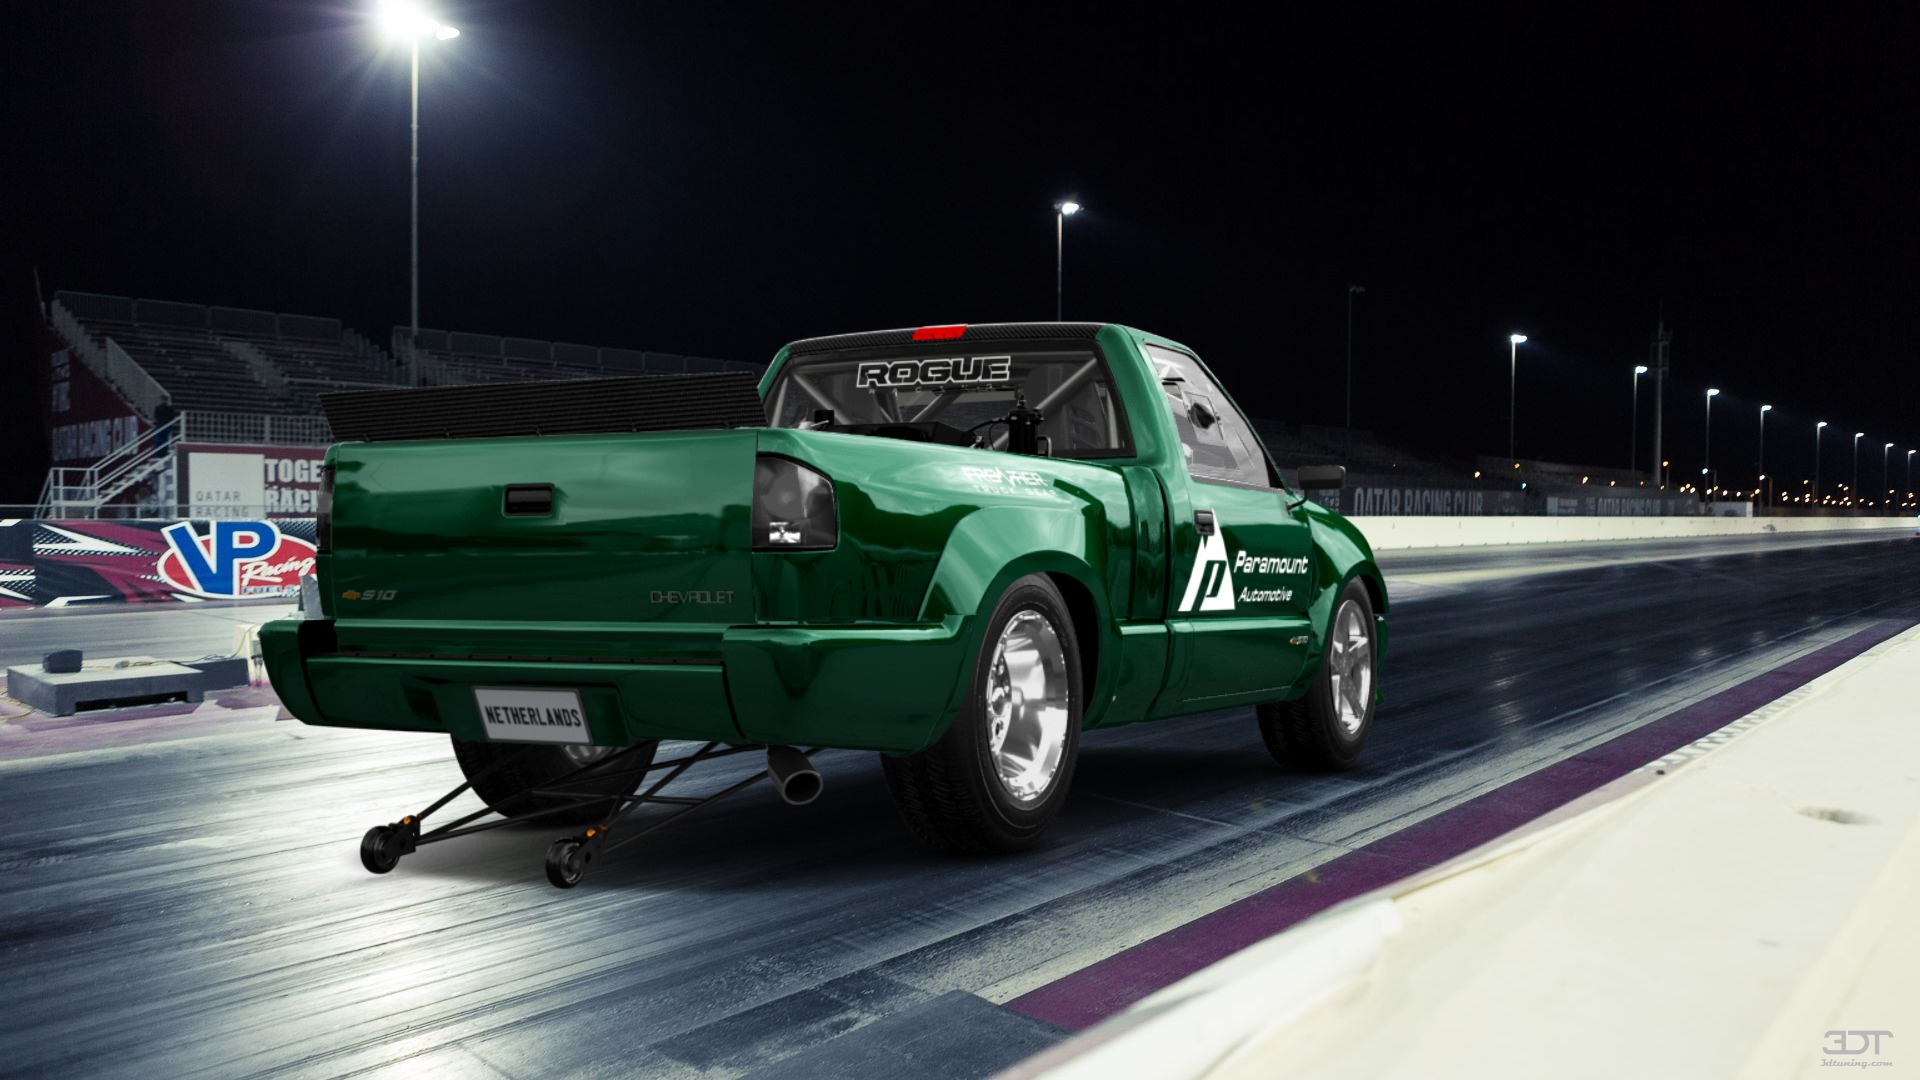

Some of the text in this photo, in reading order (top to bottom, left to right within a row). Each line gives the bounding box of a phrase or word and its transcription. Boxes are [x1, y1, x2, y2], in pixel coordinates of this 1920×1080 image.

[856, 355, 1011, 388] ROGUE
[195, 490, 241, 502] QATAR
[195, 506, 249, 518] RACING
[164, 520, 280, 597] VP
[1234, 550, 1309, 575] Paramount
[241, 556, 317, 587] Racing
[361, 589, 398, 601] S10
[649, 590, 735, 604] CHEVROLET
[1238, 586, 1293, 603] Automotive
[484, 705, 582, 727] NETHERLANDS
